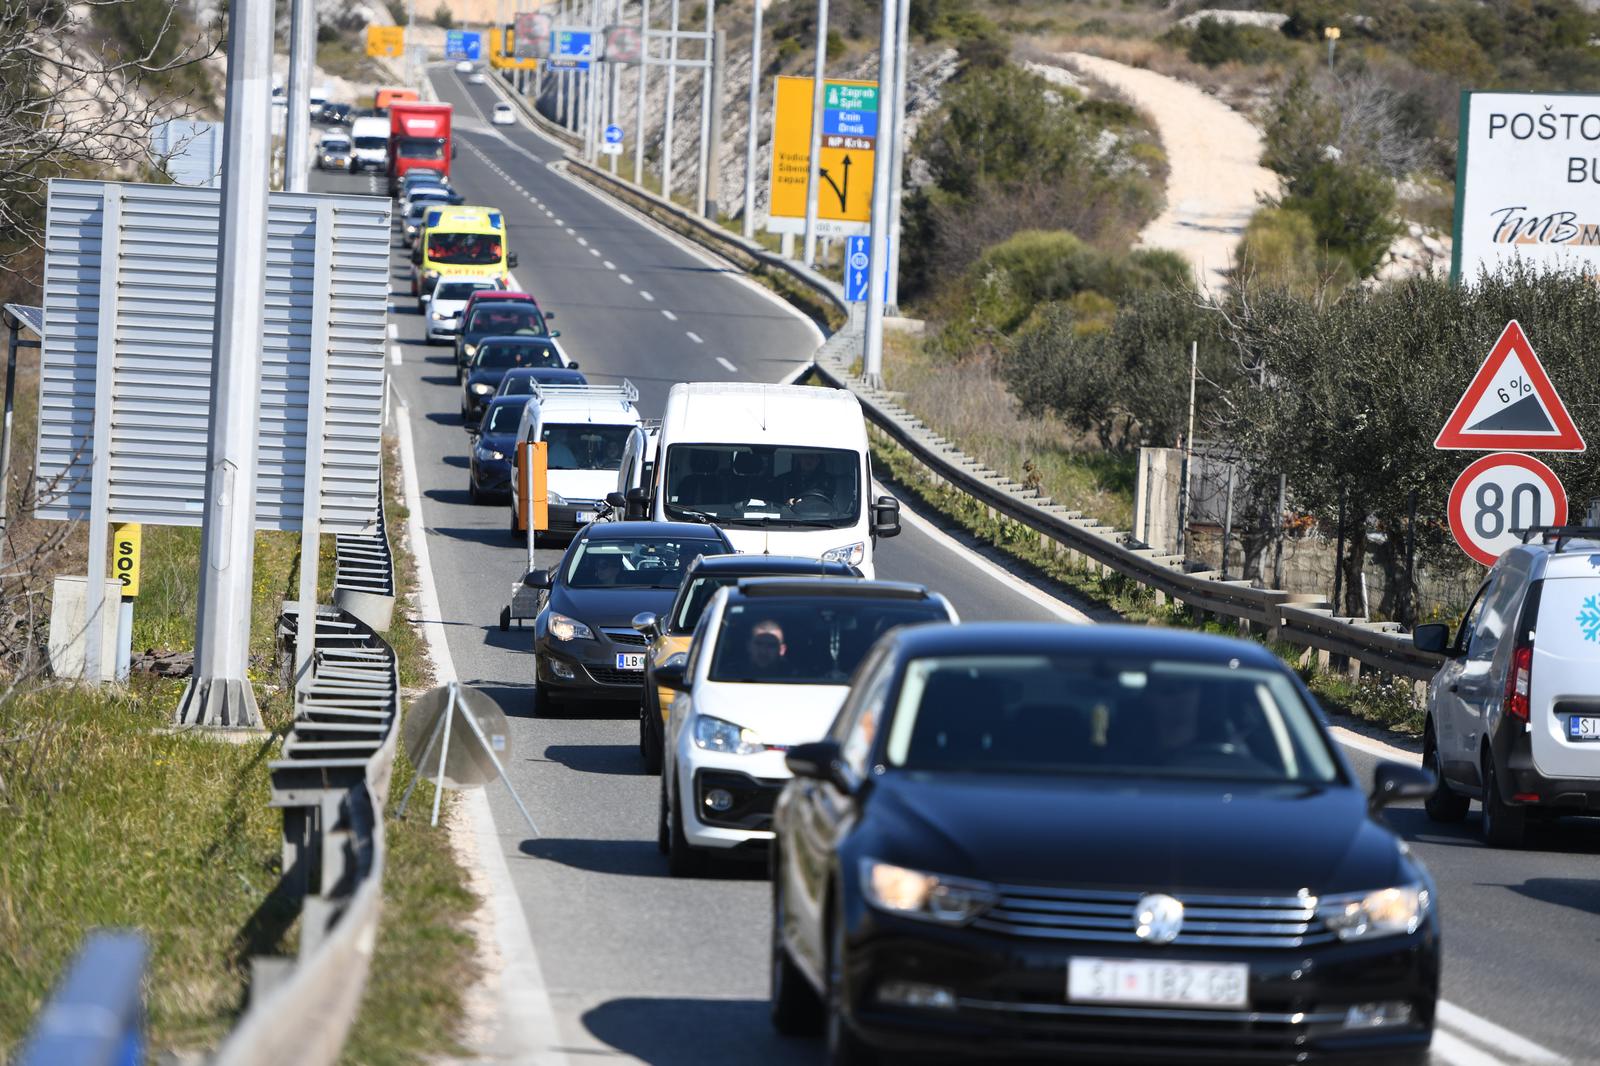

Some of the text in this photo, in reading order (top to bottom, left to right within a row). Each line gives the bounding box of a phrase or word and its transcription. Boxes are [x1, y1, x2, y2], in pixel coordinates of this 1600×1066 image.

[1474, 481, 1541, 540] 80
[117, 541, 132, 586] SOS
[625, 655, 638, 667] LB
[1581, 718, 1596, 734] SI
